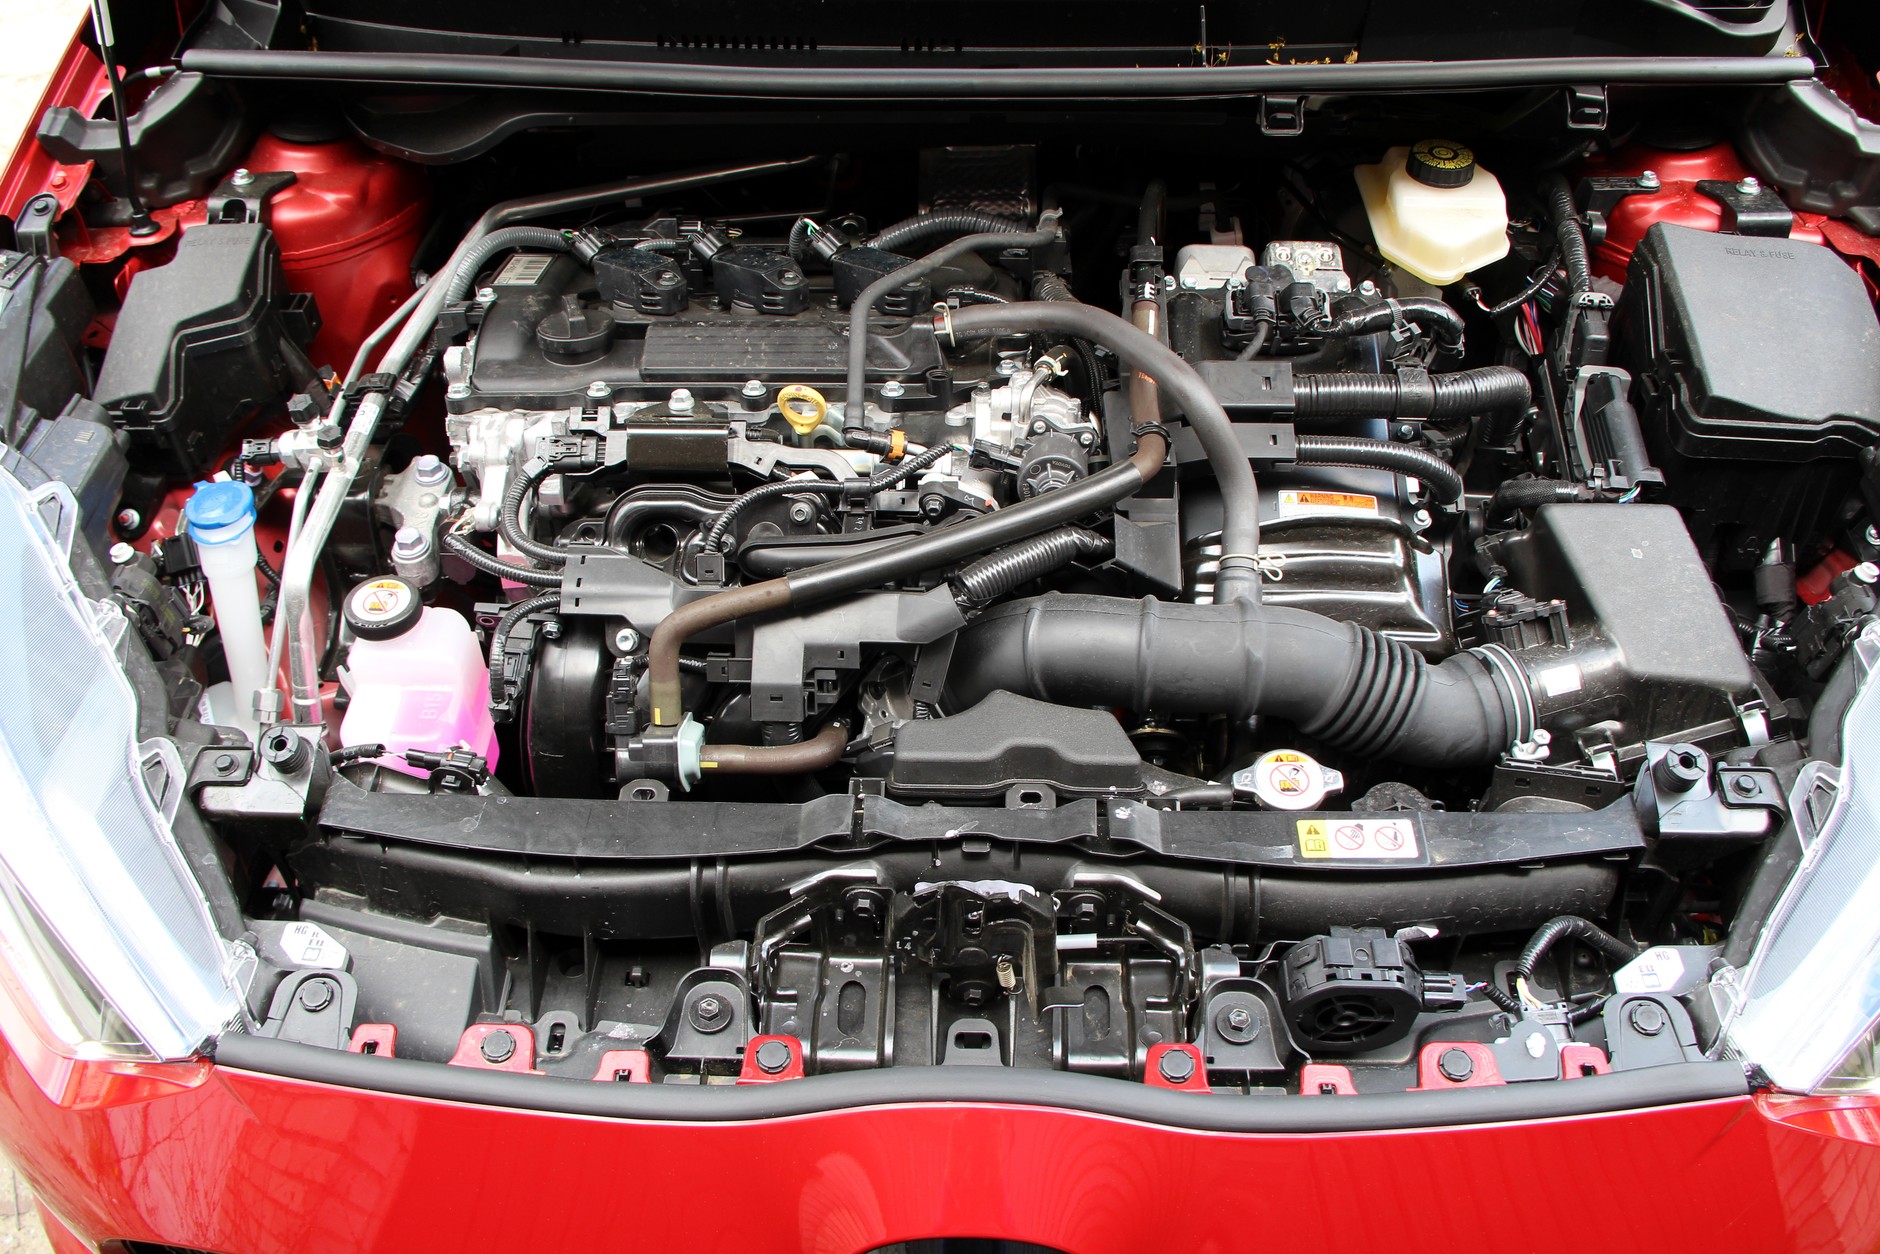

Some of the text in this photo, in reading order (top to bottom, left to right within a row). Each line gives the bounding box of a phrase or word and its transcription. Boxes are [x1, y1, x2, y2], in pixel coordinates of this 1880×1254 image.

[1725, 247, 1796, 260] RELAY & FUSE
[806, 396, 818, 405] OIL
[1051, 460, 1071, 469] TOYOTA
